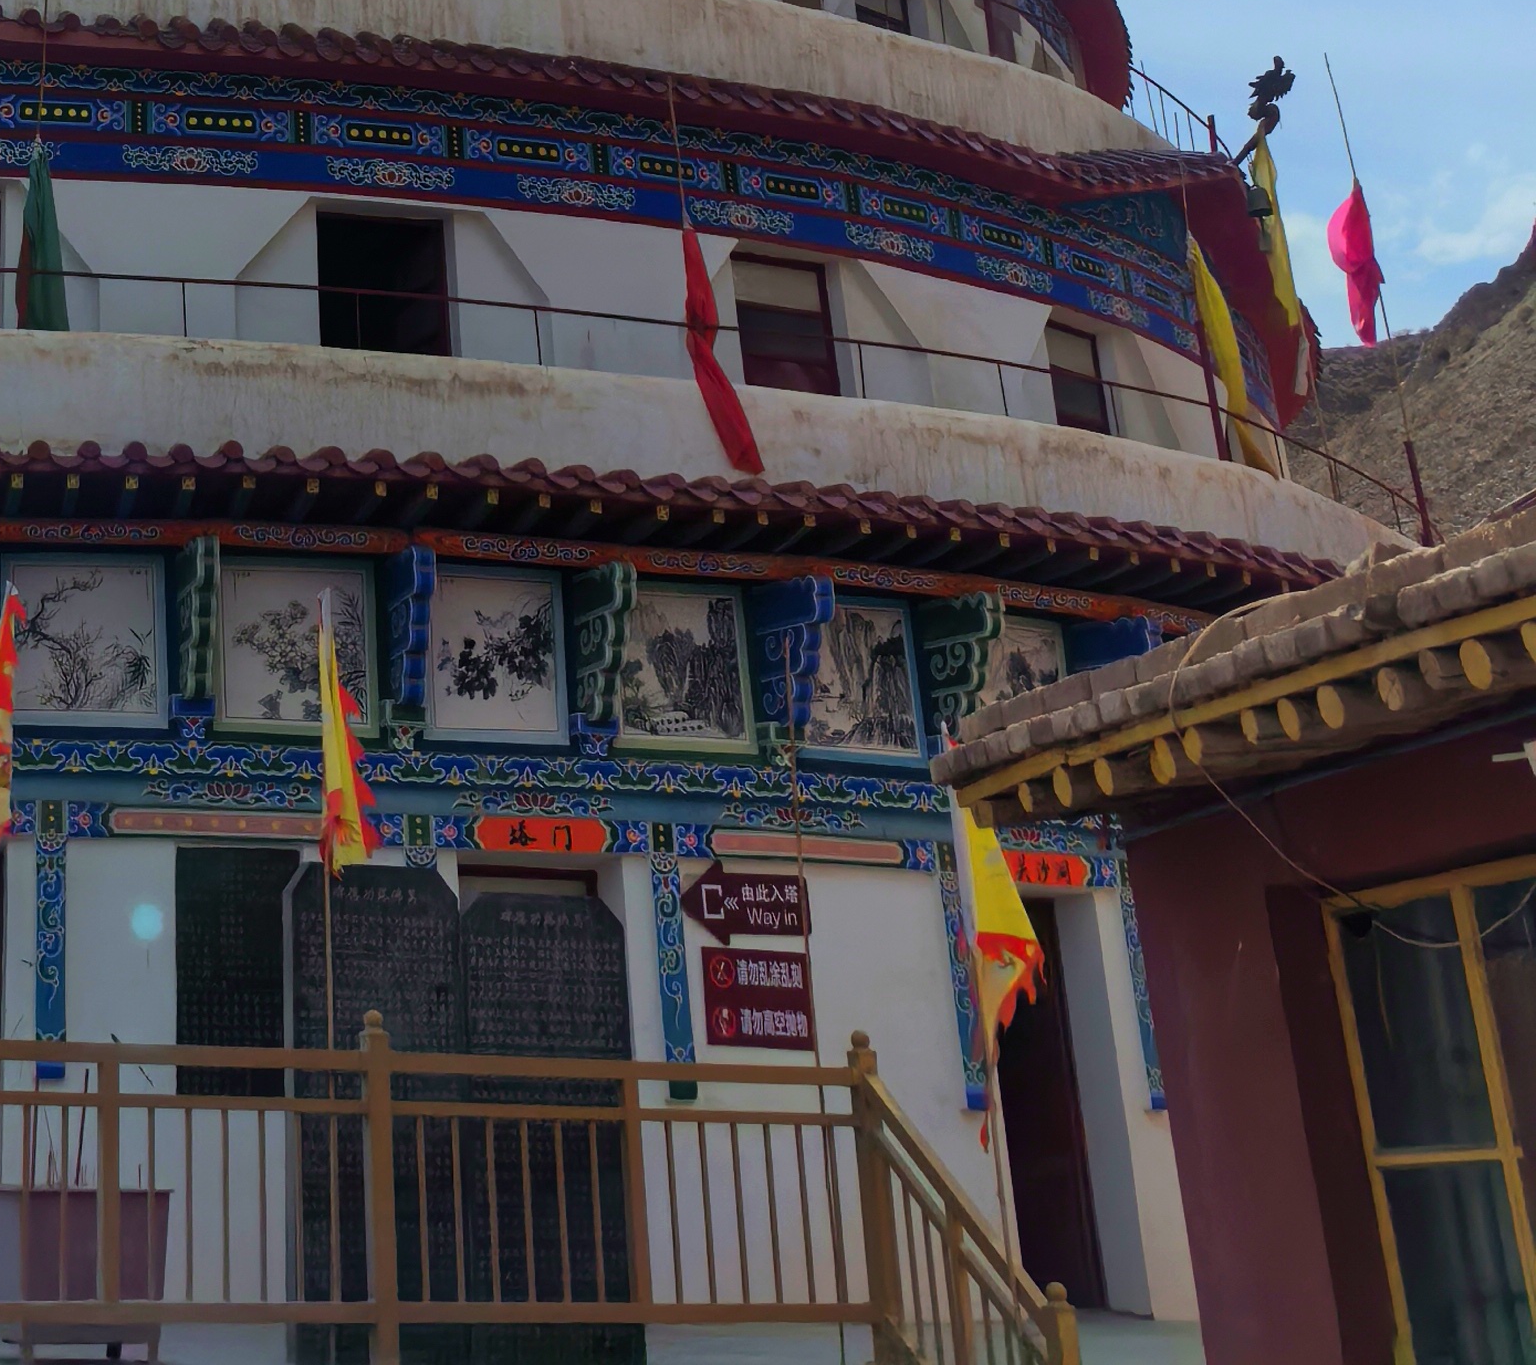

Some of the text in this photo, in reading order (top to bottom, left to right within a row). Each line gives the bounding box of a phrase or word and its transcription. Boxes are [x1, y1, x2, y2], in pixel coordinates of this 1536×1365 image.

[741, 883, 799, 904] 由此入塔
[746, 906, 798, 929] Way in
[736, 959, 804, 990] 请勿乱涂乱刻
[739, 1007, 809, 1038] 请勿高空抛物
